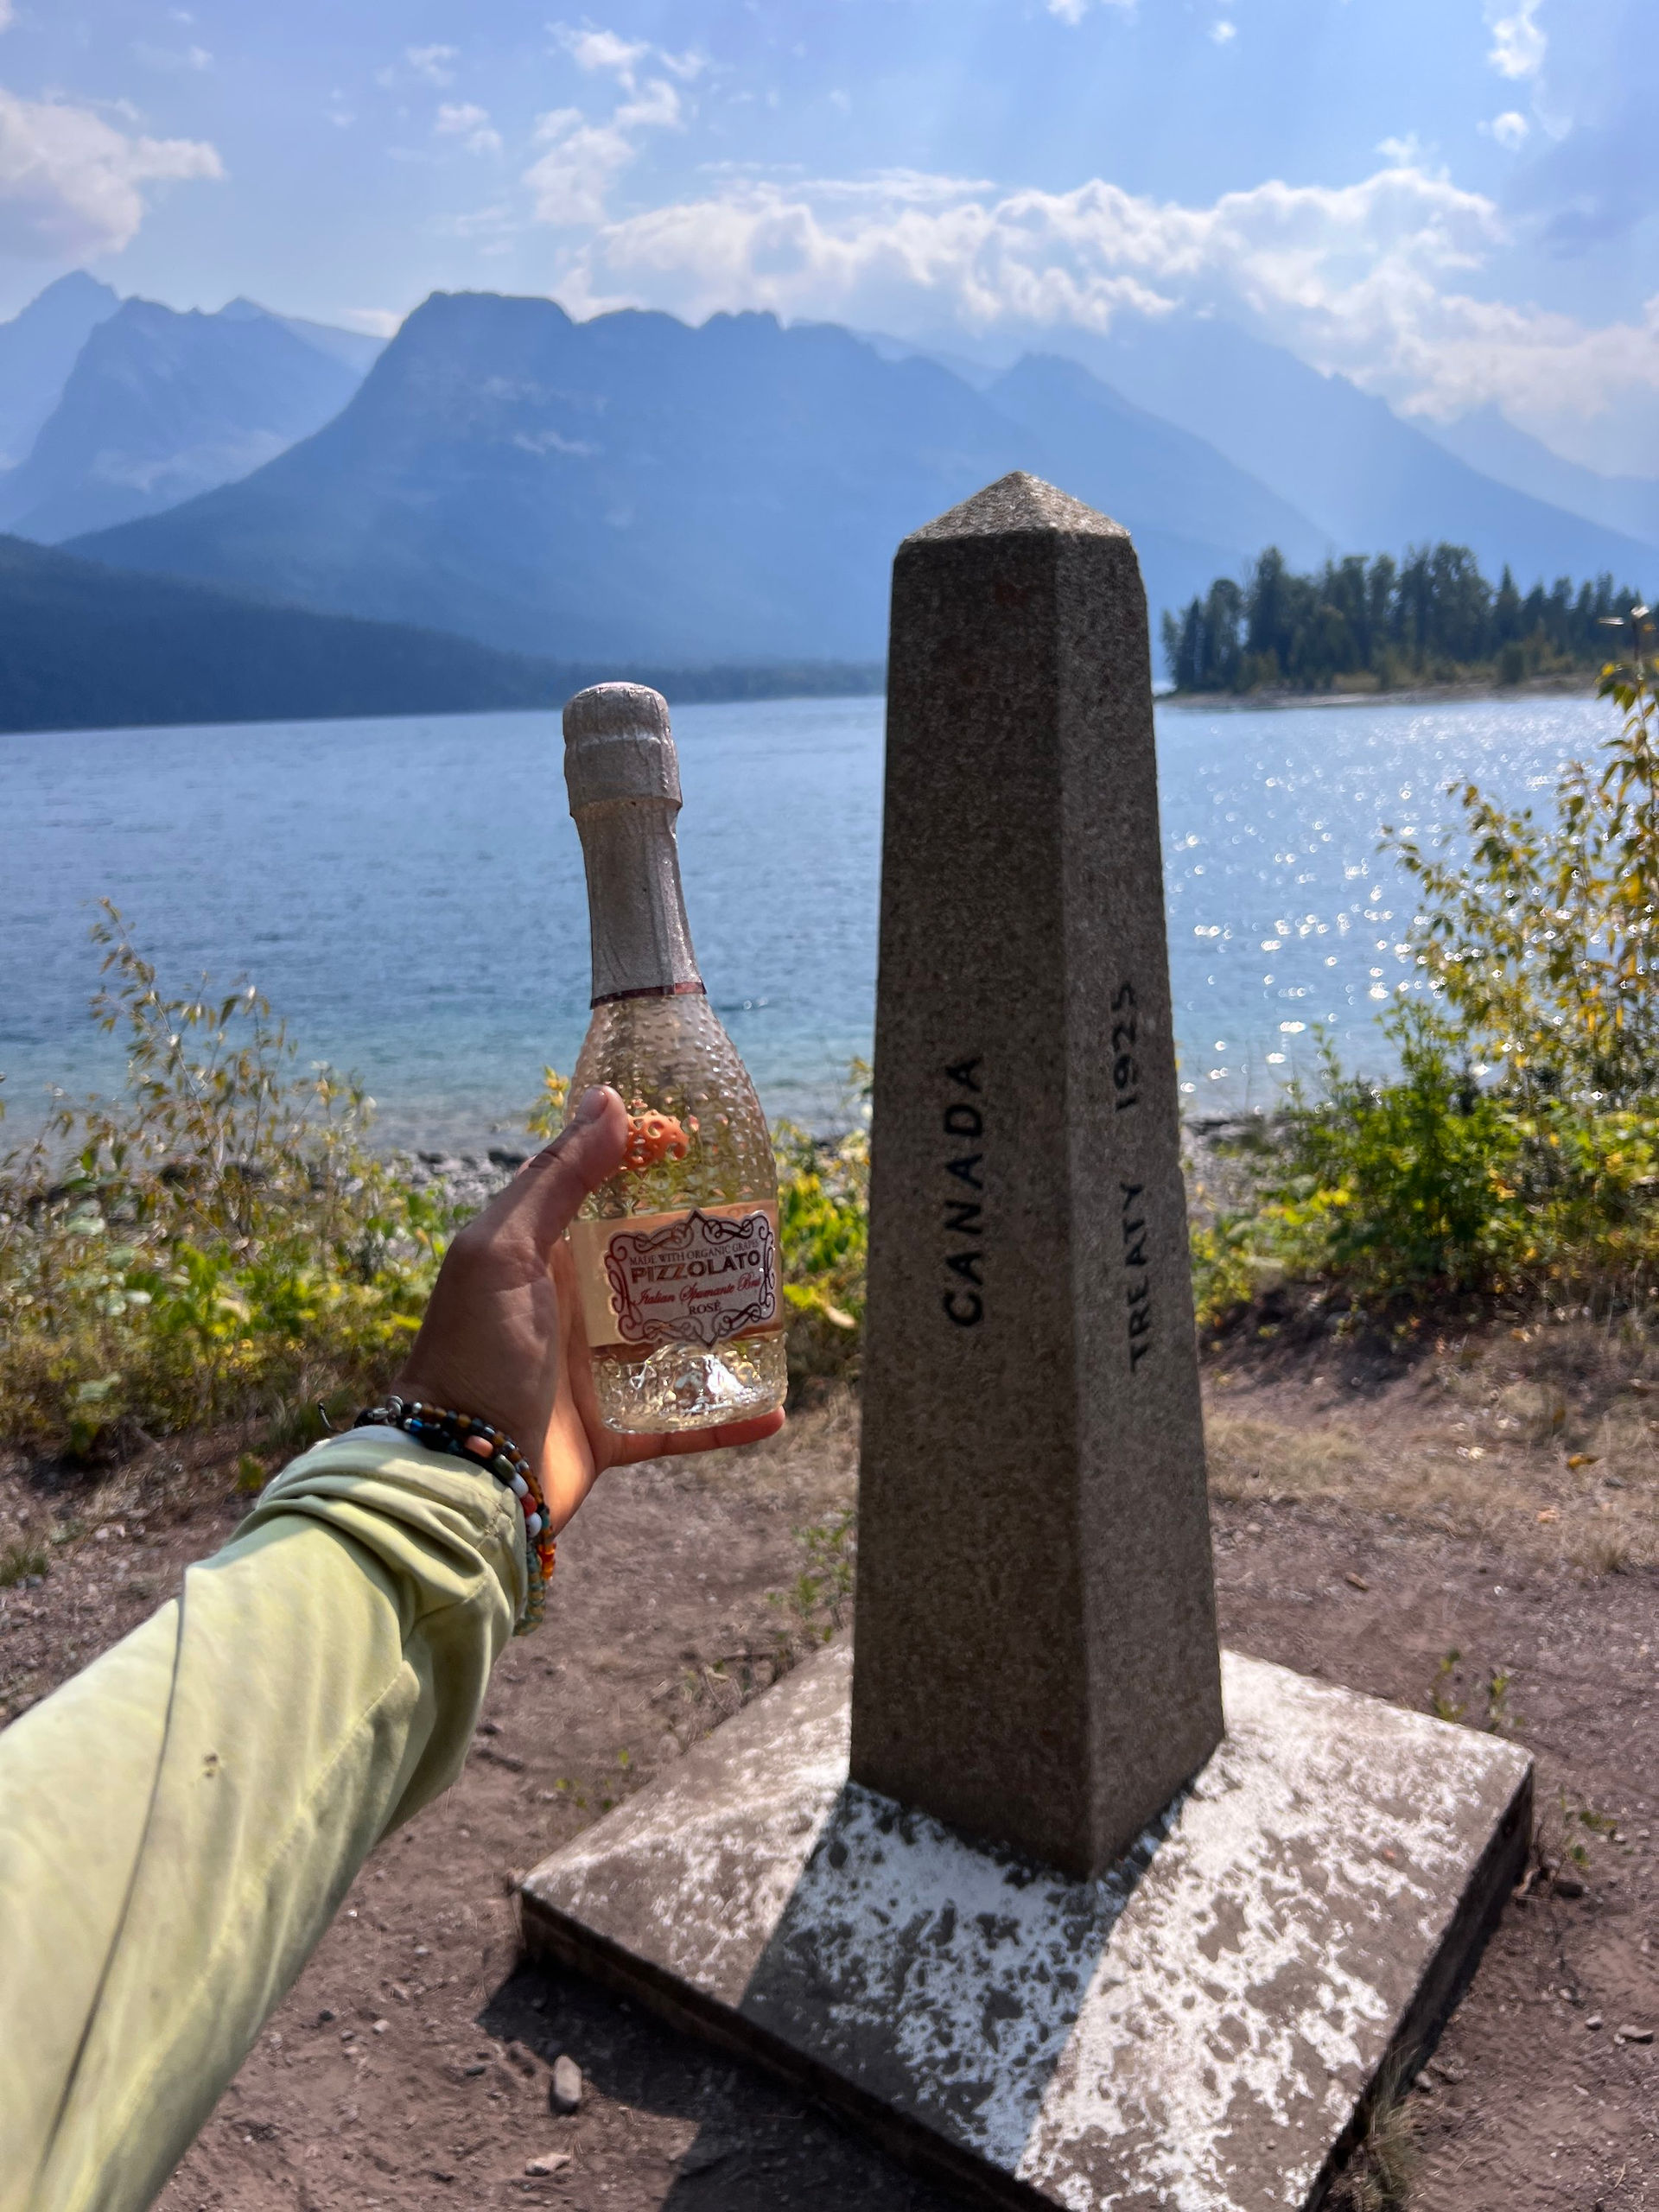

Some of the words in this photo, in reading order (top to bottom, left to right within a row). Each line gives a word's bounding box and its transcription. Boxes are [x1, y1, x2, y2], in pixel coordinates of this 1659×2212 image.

[1111, 981, 1139, 1112] 1925
[941, 1055, 984, 1328] CANADA
[629, 1255, 656, 1266] MADE
[658, 1252, 685, 1262] WITH
[687, 1244, 732, 1260] ORGANIC
[630, 1250, 761, 1284] PIZZOLATO
[1120, 1180, 1151, 1374] TREATY
[634, 1287, 675, 1306] Italian
[679, 1282, 735, 1307] Spumante
[689, 1300, 721, 1315] ROSÉ
